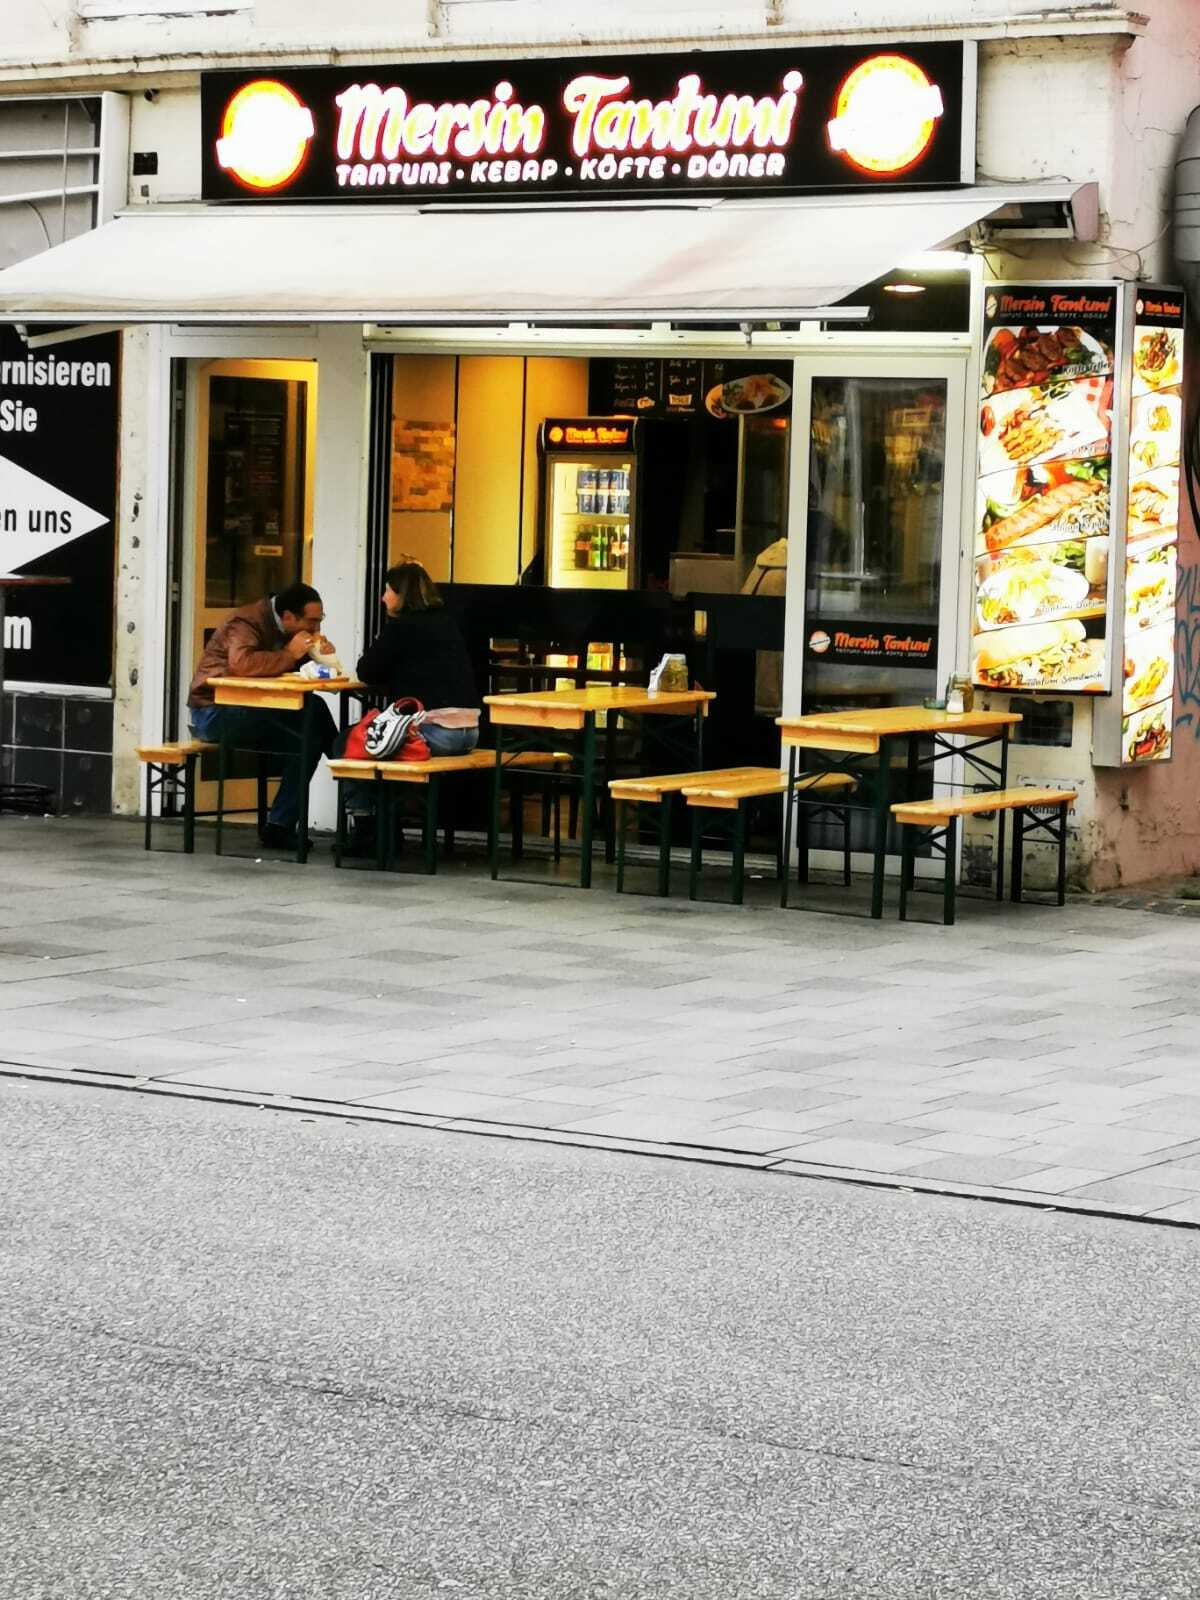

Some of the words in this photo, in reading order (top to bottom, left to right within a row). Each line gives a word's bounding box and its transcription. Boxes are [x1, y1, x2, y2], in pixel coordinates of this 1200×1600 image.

[335, 81, 544, 161] Mersin
[563, 70, 803, 157] Tantuni
[335, 161, 449, 187] TANTUNI
[470, 159, 557, 183] KEBAP
[580, 152, 665, 181] KÖFTE
[687, 149, 785, 178] DÖNER
[0, 353, 111, 386] rnisieren
[0, 400, 37, 432] Sie
[29, 510, 71, 533] uns
[835, 632, 879, 650] Mersin
[883, 634, 932, 652] Tantuni
